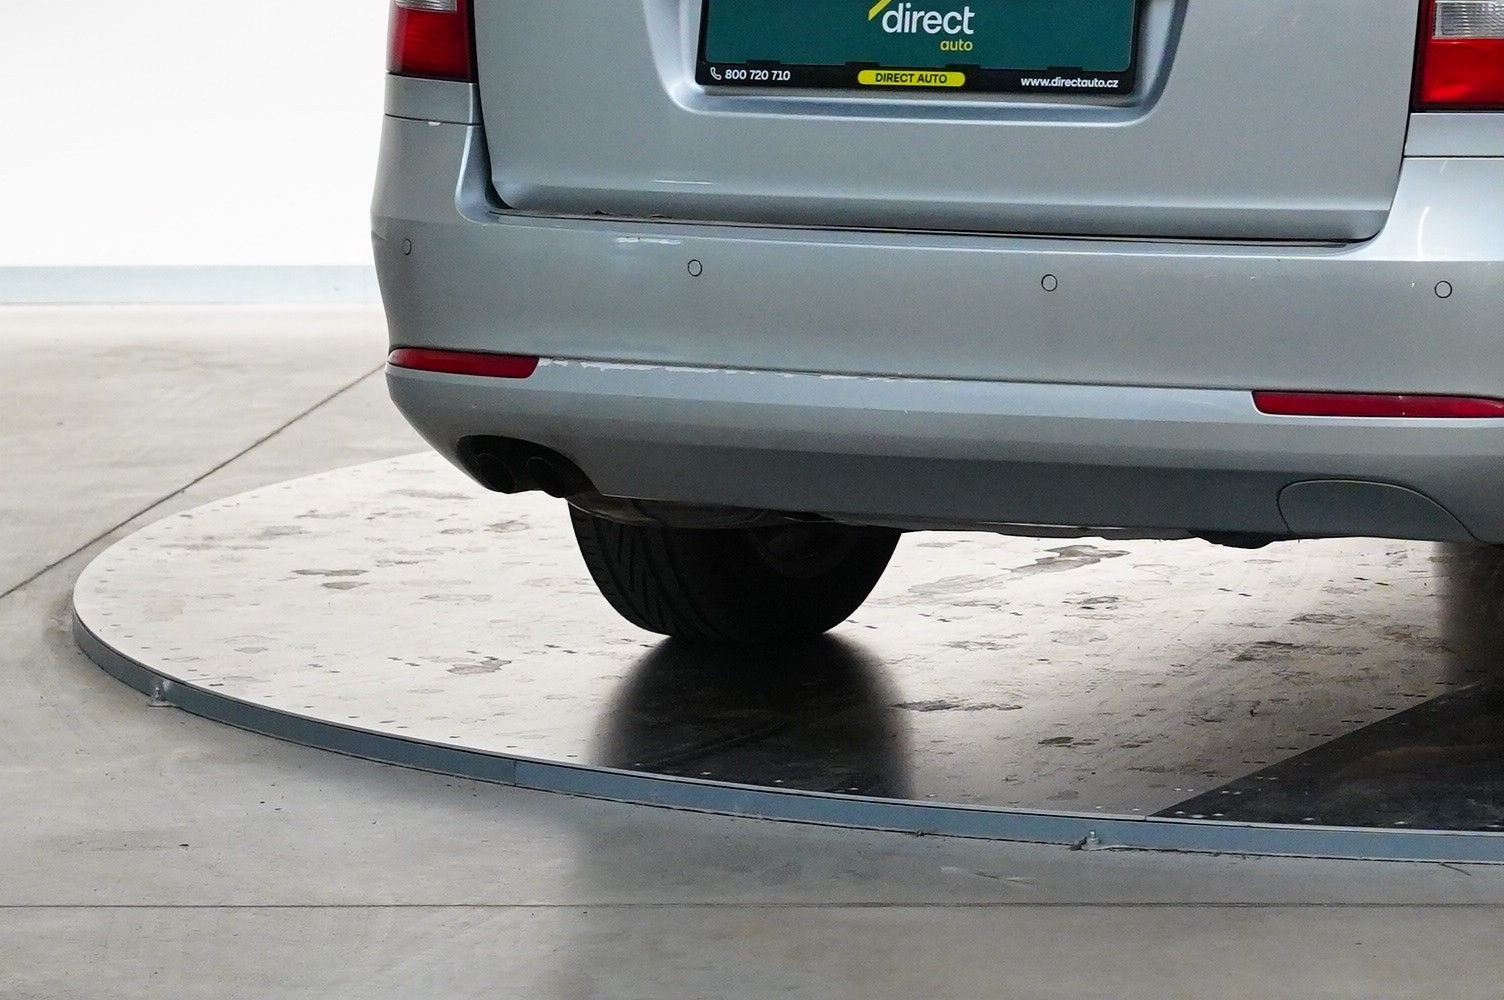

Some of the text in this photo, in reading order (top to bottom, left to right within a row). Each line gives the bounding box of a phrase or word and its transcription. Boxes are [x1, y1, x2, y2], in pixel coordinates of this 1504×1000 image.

[882, 2, 976, 35] direct
[940, 39, 973, 51] auto
[724, 69, 791, 81] 800 720 710
[875, 73, 948, 84] DIRECT AUTO
[1020, 76, 1119, 88] www.directauto.cz
